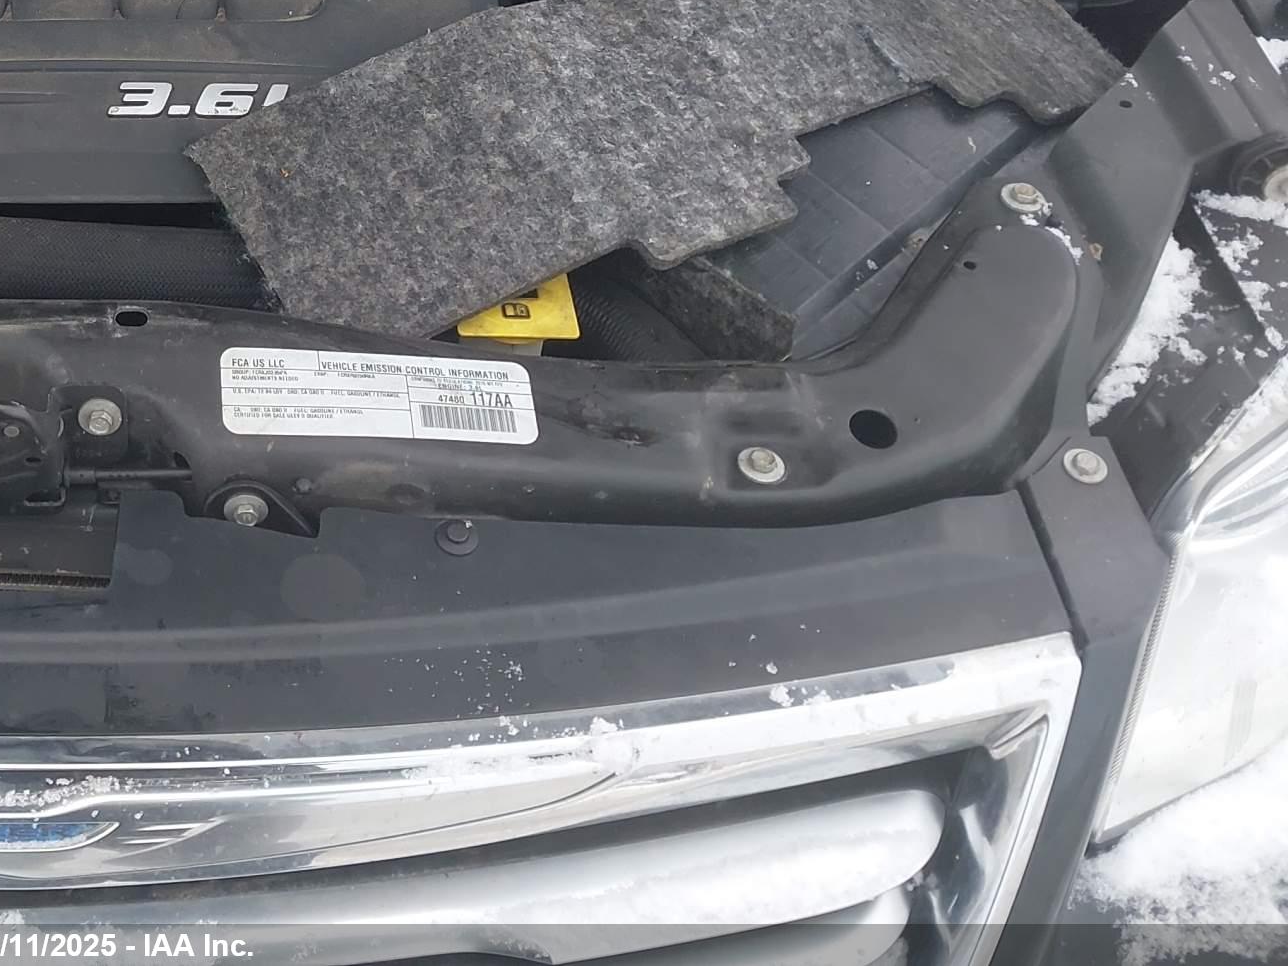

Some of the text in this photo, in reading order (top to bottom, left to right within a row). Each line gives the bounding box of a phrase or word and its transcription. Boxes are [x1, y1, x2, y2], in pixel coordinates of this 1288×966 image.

[232, 358, 285, 368] FCA US LLC
[321, 361, 509, 380] VEHICLE EMISSION CONTROL INFORMATION
[438, 391, 513, 408] 47480 117AA
